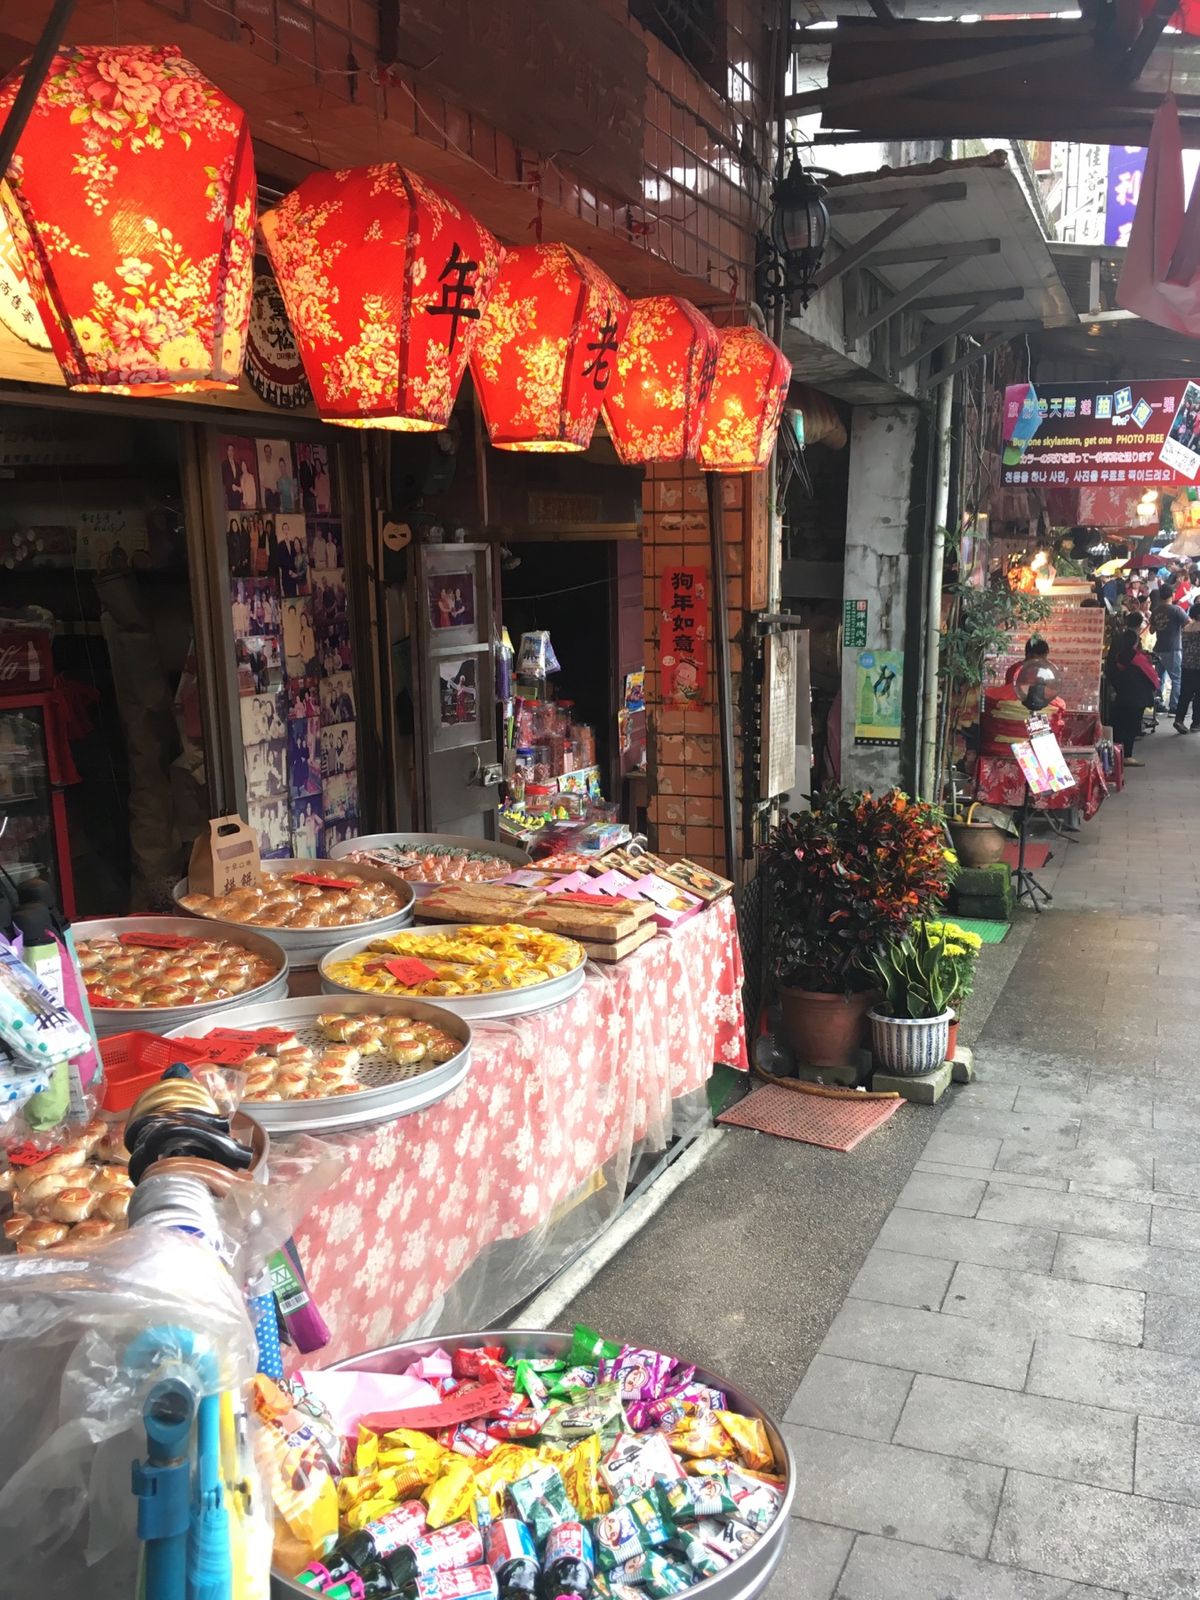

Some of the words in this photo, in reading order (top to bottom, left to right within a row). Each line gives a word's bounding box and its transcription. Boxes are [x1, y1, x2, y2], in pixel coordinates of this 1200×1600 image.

[426, 241, 480, 355] 年
[582, 309, 618, 390] 老
[1013, 438, 1026, 448] Buy
[1028, 439, 1042, 447] one
[1043, 436, 1082, 448] skylantern,
[1084, 437, 1098, 447] get
[1116, 435, 1144, 444] PHOTO
[1145, 434, 1165, 444] FREE
[1031, 471, 1047, 483] 하나
[671, 571, 695, 654] 狗年如意
